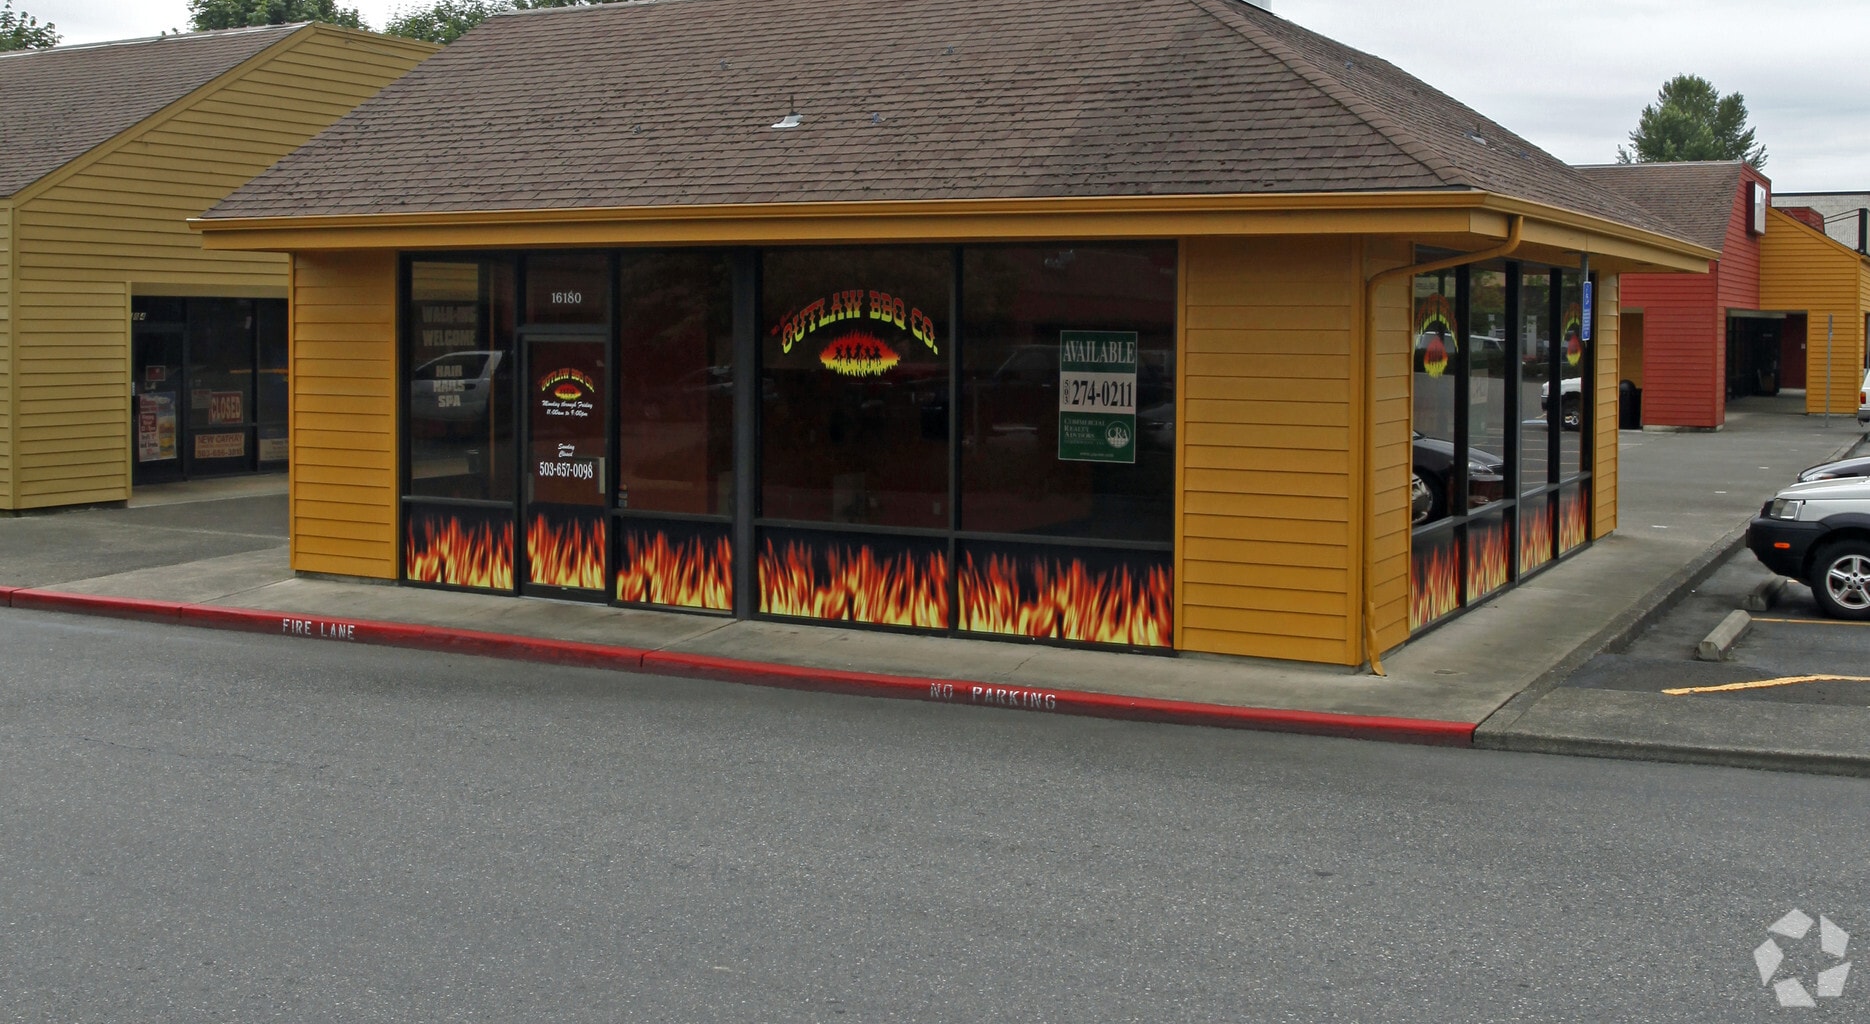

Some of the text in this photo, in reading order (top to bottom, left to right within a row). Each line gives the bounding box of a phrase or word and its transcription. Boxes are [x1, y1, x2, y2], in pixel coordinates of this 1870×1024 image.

[551, 291, 582, 304] 16180
[781, 289, 939, 356] OUTLAW BBQ CO.
[422, 329, 476, 346] WELCOME
[1064, 341, 1135, 364] AVAILABLE
[438, 395, 461, 408] SPA
[1071, 379, 1133, 407] 274-0211
[211, 395, 241, 420] CLOSED
[1107, 426, 1128, 440] CRA
[539, 461, 593, 480] 503-657-0098
[282, 618, 355, 640] FIRE LANE
[930, 682, 1056, 710] NO PARKING
